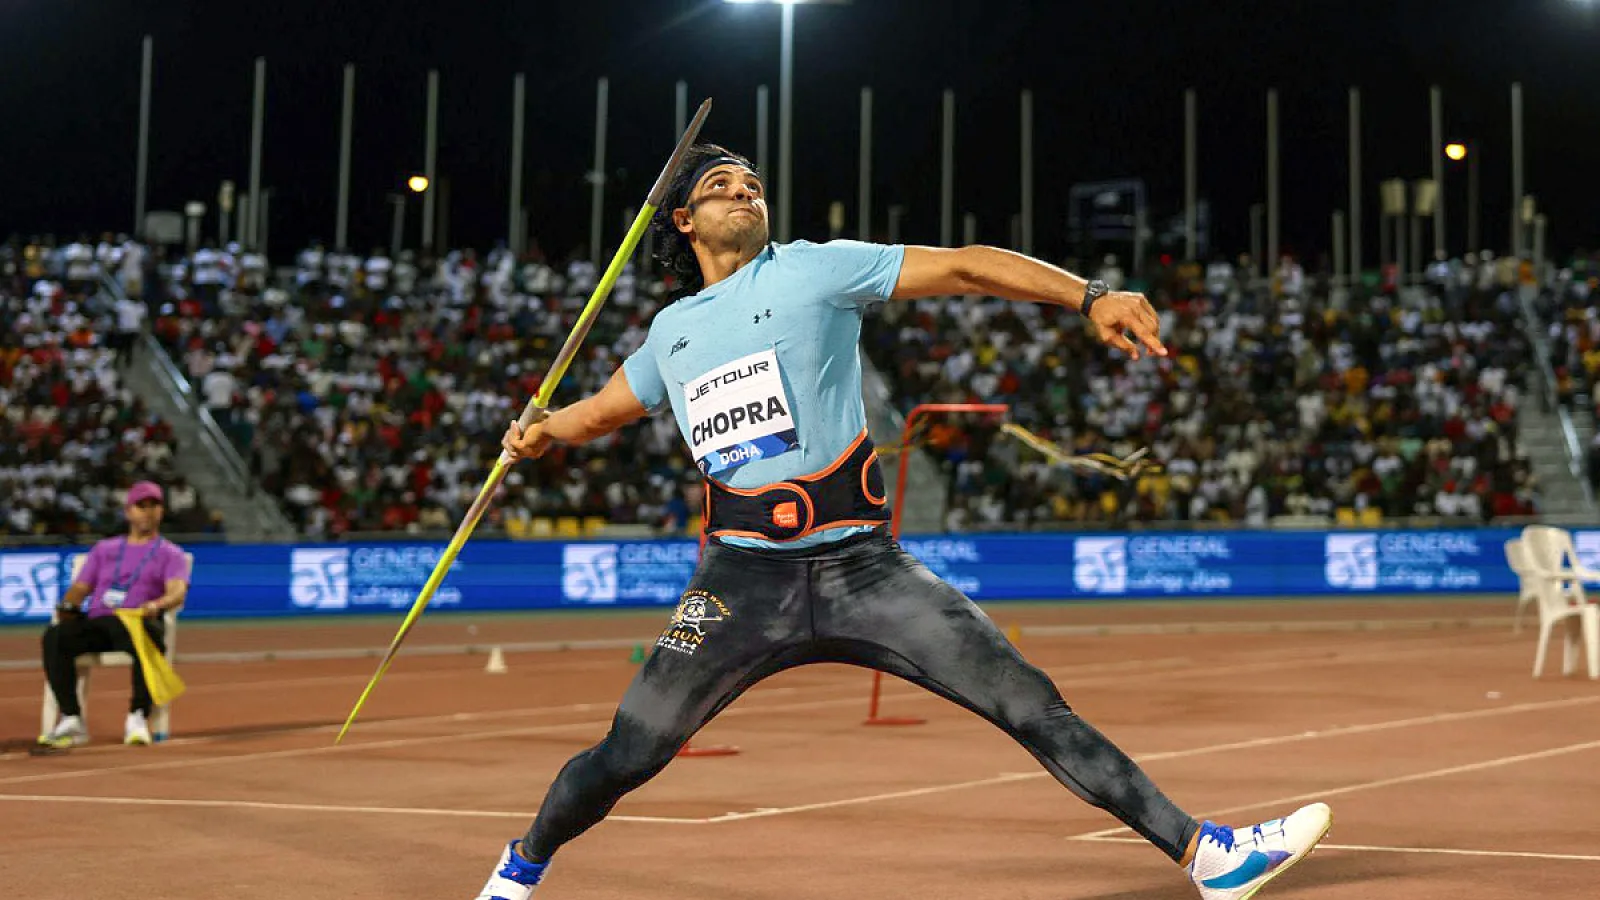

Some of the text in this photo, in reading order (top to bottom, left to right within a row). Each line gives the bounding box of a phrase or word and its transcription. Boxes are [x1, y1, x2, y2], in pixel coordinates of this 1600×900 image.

[690, 361, 769, 402] JETOUR
[692, 396, 787, 446] CHOPRA
[719, 444, 761, 465] DOHA
[1129, 536, 1232, 558] GENERAL
[1380, 532, 1481, 555] GENERAL
